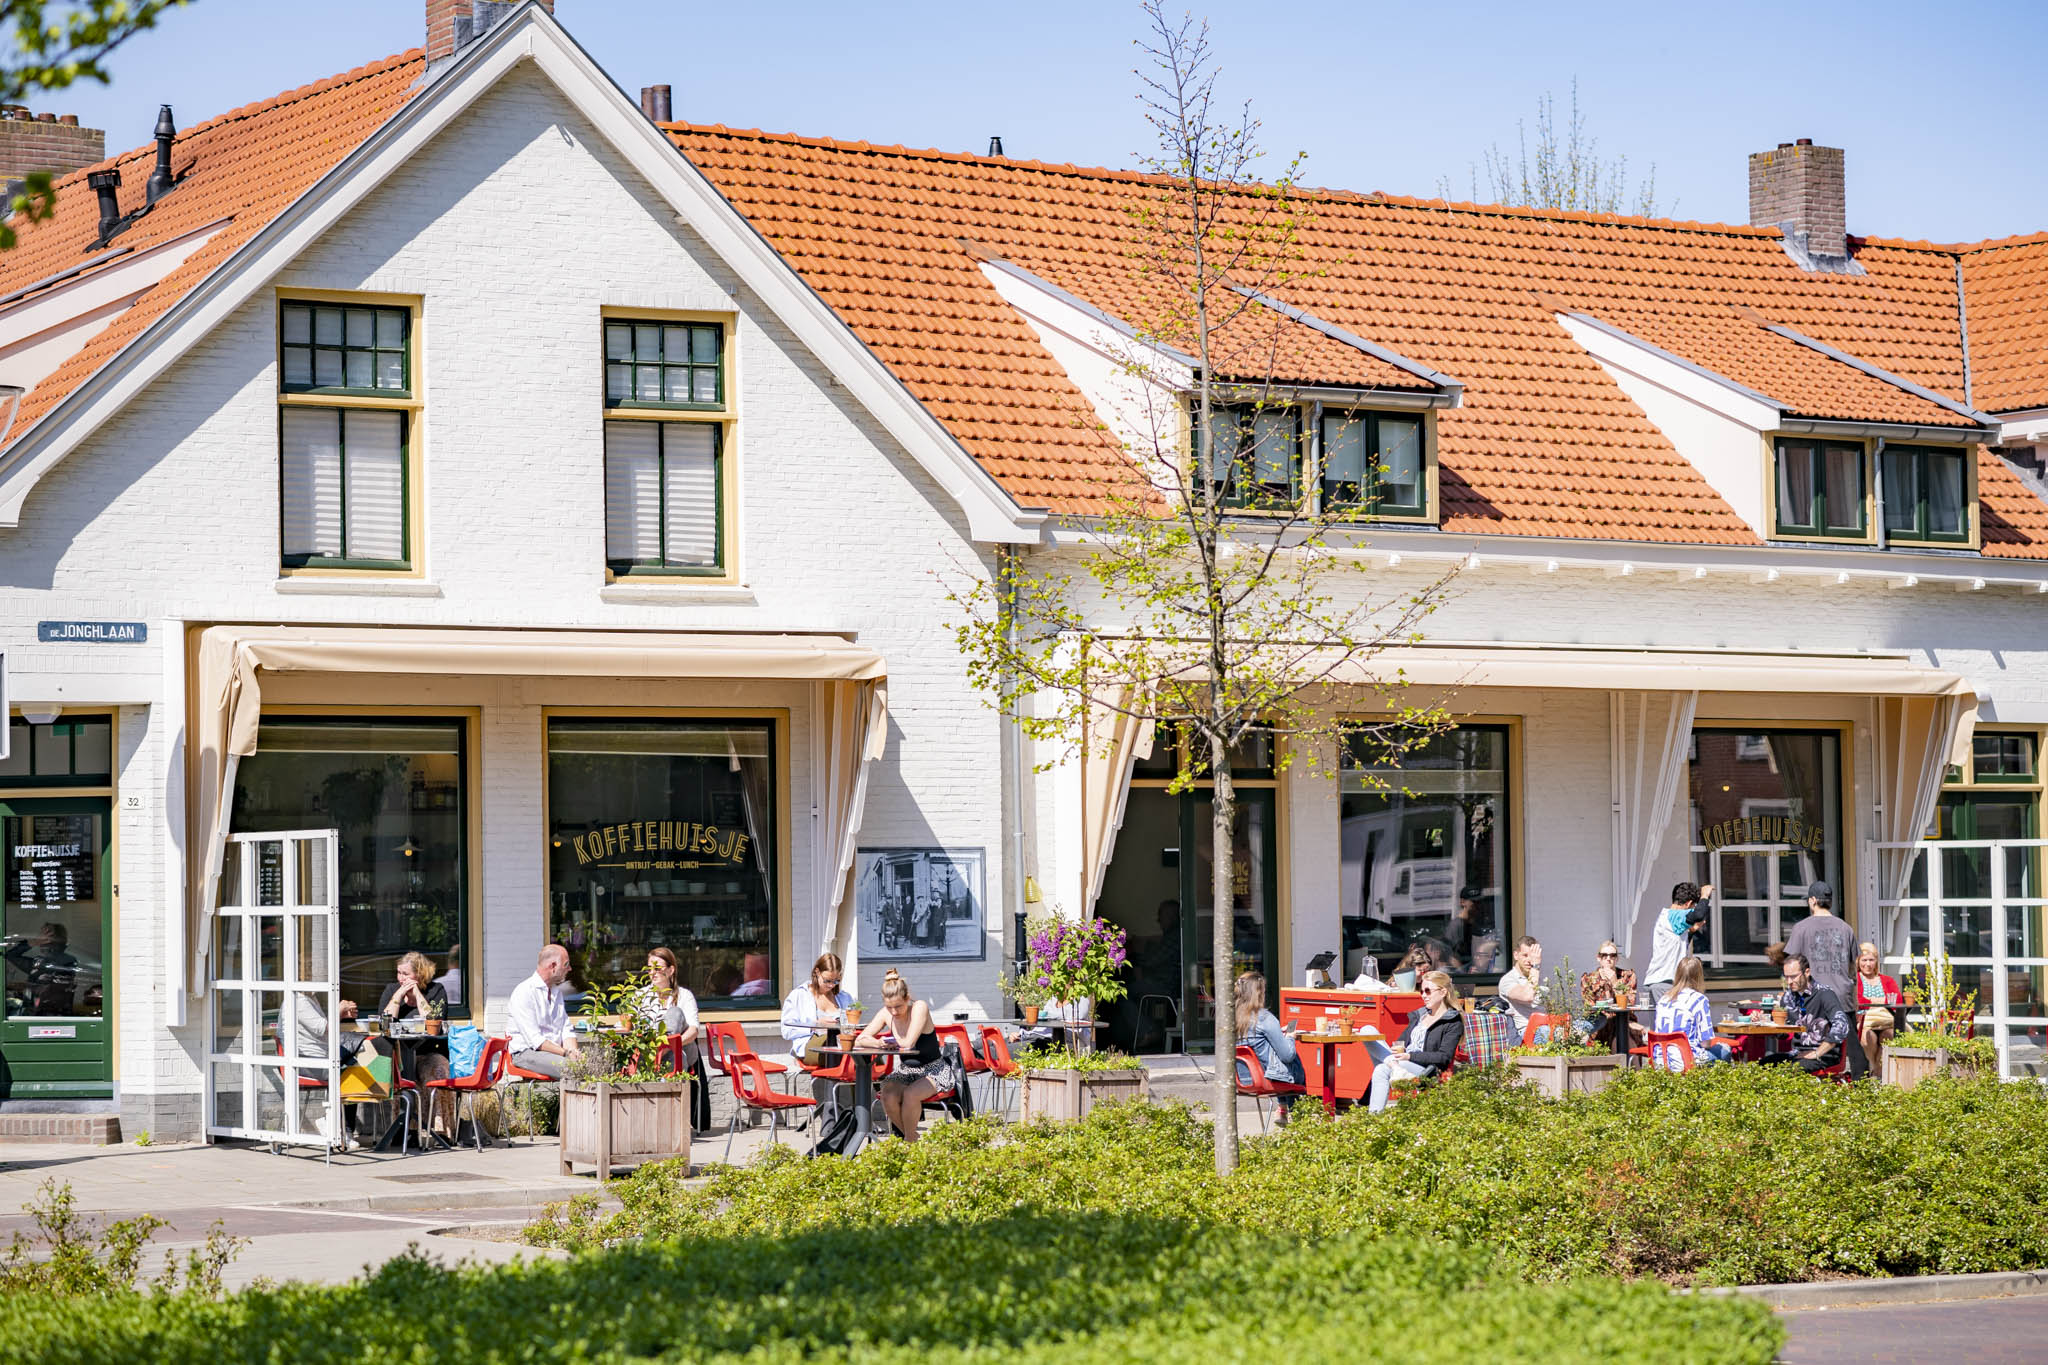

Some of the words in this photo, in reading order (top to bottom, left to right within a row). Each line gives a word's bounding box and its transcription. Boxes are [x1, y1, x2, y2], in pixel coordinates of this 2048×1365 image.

[60, 624, 135, 639] JONGHLAAN
[127, 797, 139, 807] 32
[1702, 816, 1824, 853] KOFFIEHUISJE
[573, 821, 750, 865] KOFFIEHUISJE
[14, 844, 80, 858] KOFFIEHUISJE
